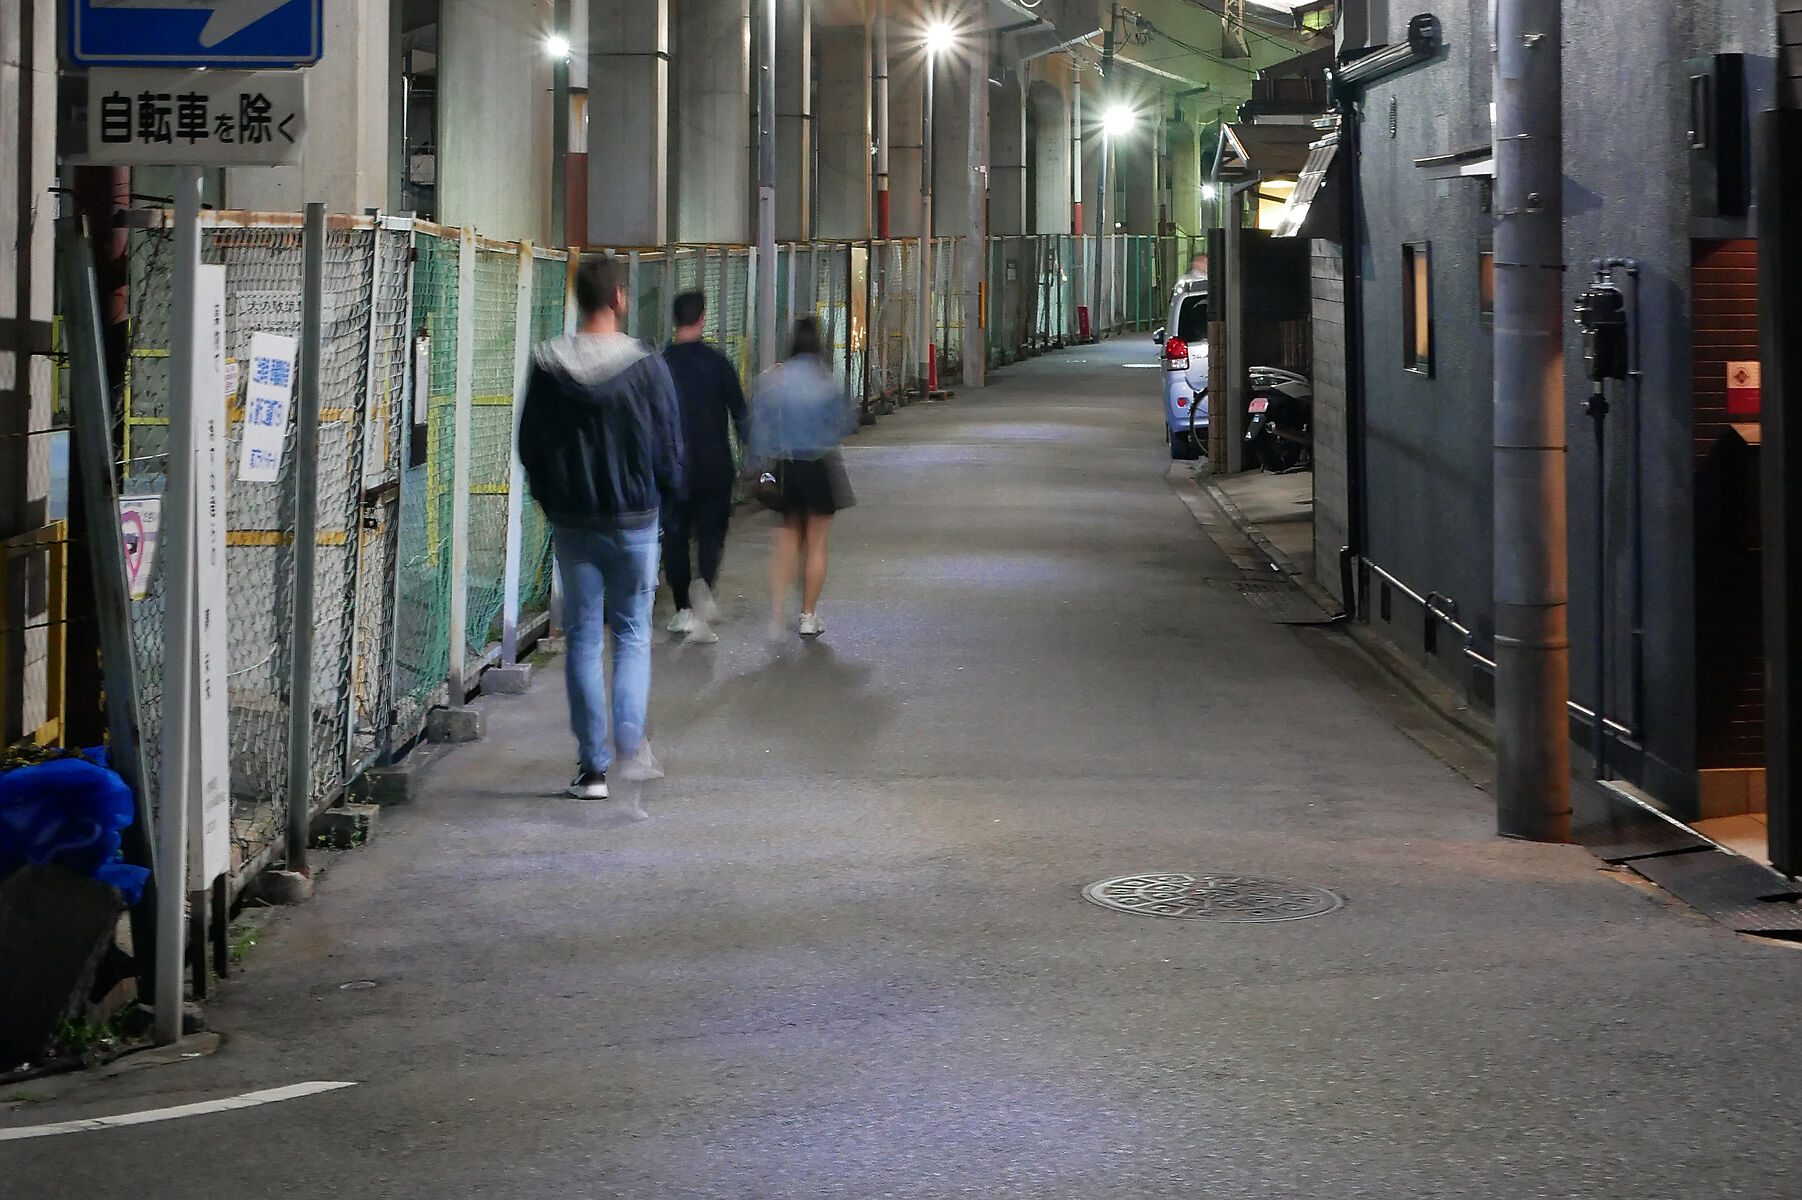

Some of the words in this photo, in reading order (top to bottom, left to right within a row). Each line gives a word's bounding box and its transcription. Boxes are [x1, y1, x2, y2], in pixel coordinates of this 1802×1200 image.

[101, 90, 296, 145] 自転車を除く
